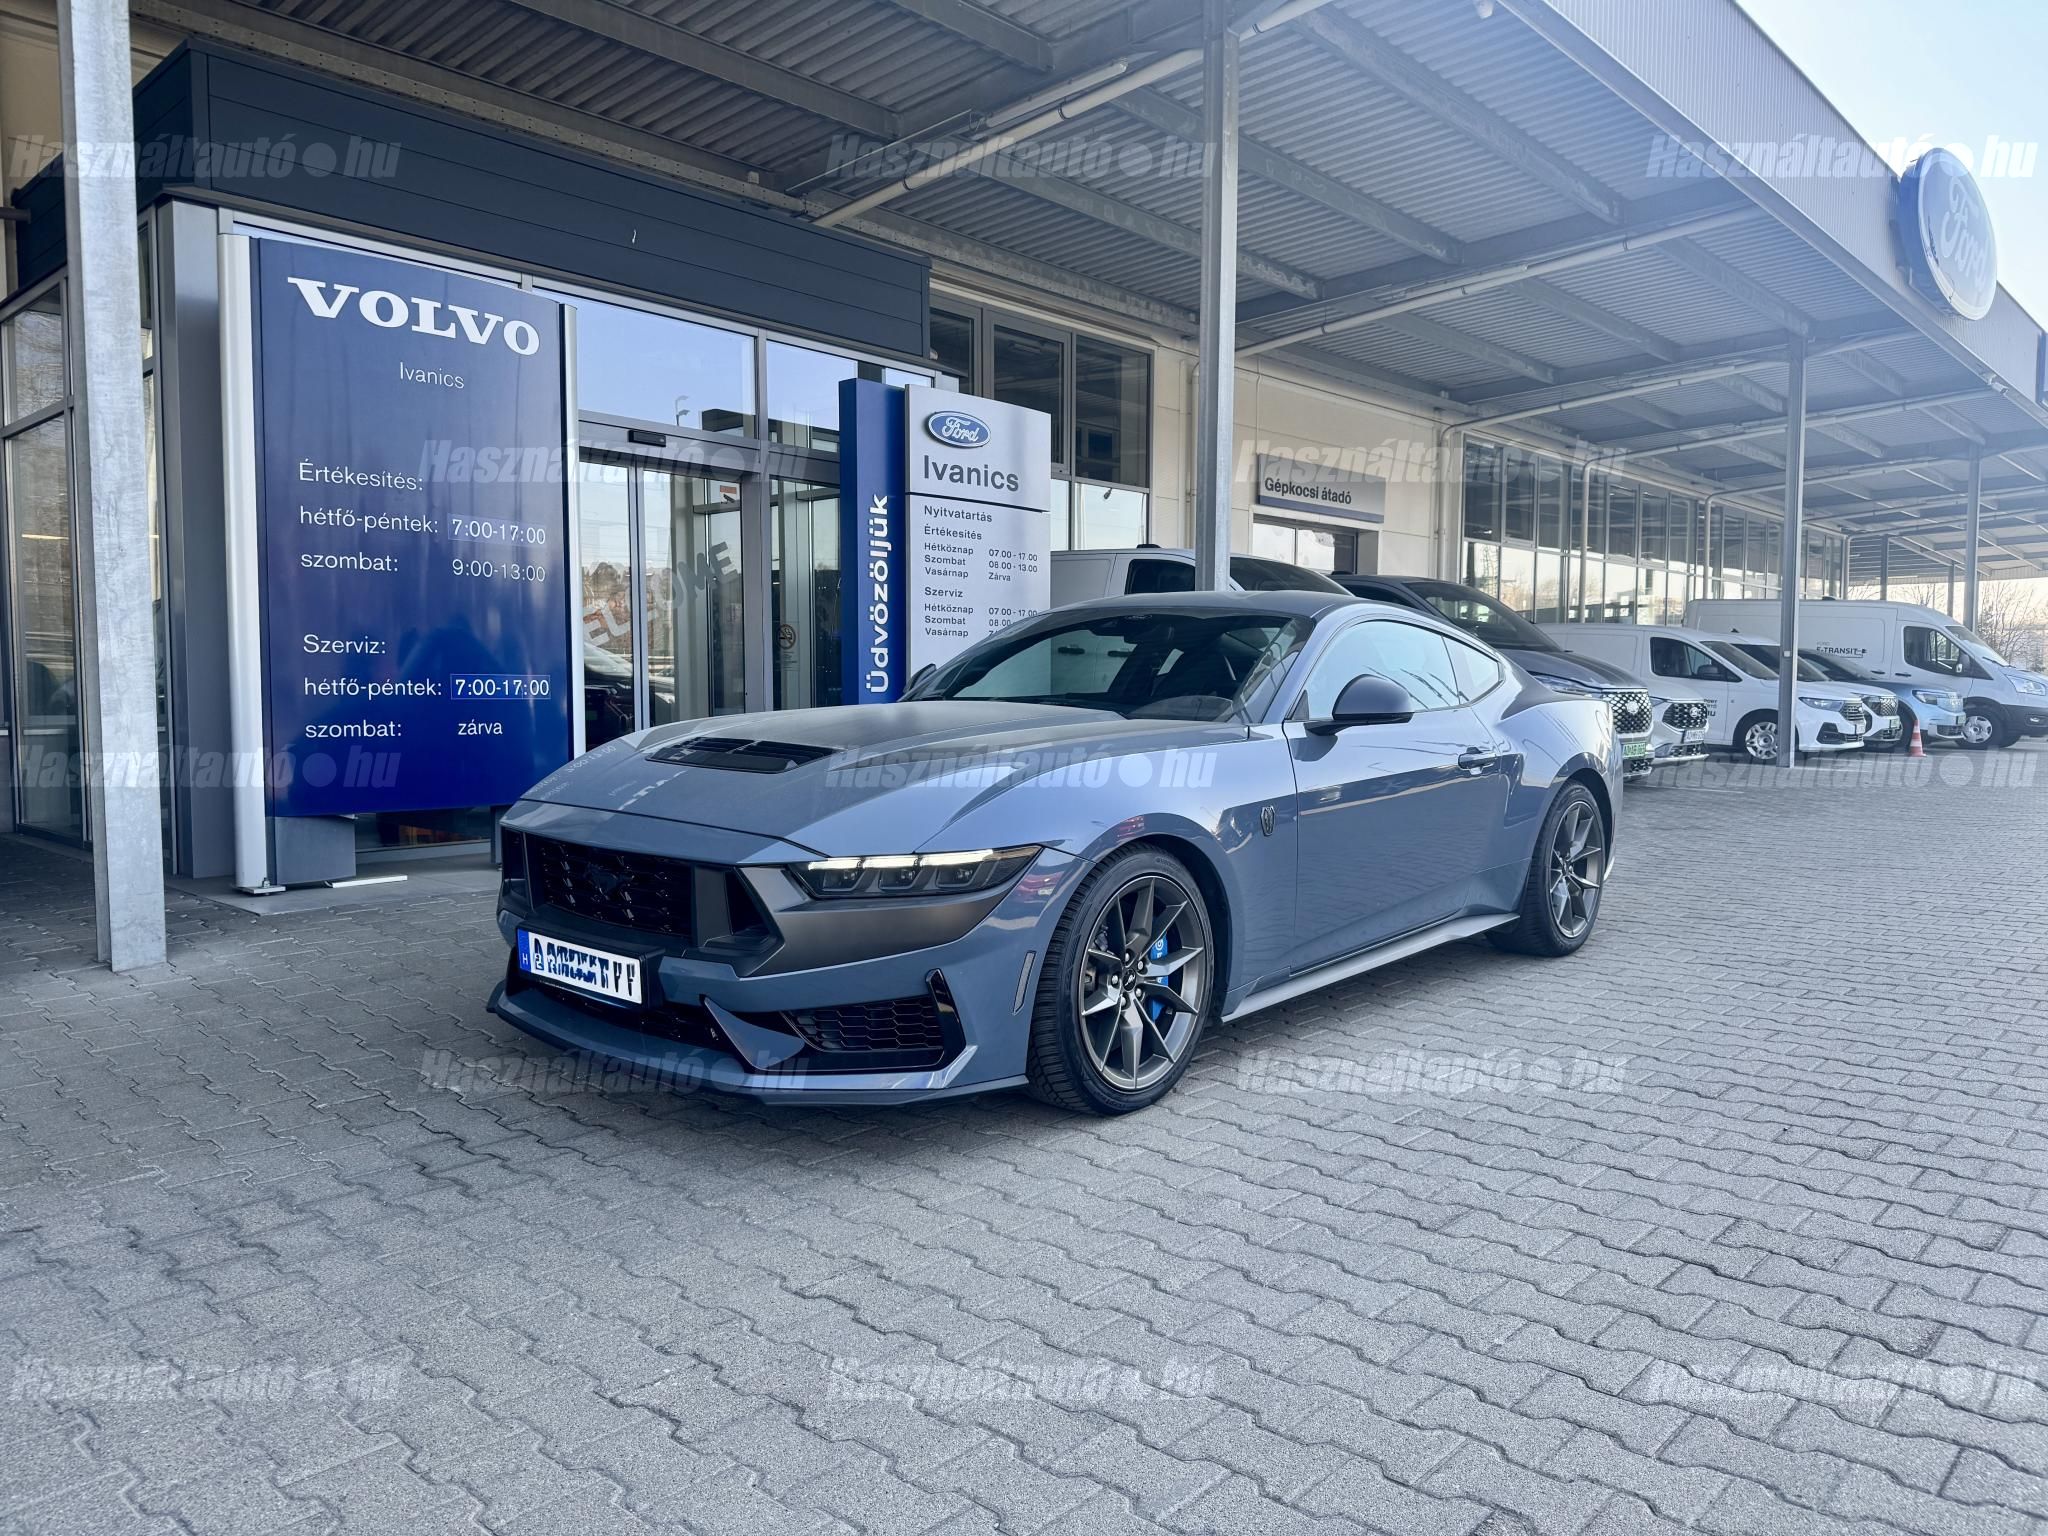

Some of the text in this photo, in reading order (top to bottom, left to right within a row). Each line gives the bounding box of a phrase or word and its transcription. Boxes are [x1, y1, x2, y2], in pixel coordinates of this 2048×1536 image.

[1940, 177, 1988, 290] Ford
[287, 276, 540, 356] VOLVO
[399, 361, 465, 389] Ivanics
[941, 416, 980, 442] Ford
[299, 458, 424, 491] Értékesítés:
[923, 454, 1019, 492] Ivanics
[1264, 477, 1352, 505] Gépkocsi átadó
[924, 505, 993, 522] Nyitvatartás
[300, 506, 546, 545] hétfő-péntek: 7:00-17:00
[924, 543, 974, 555] Hétköznap
[988, 549, 1012, 559] 07.00
[1018, 552, 1038, 561] 17.00
[301, 551, 546, 582] szombat: 9:00-13:00
[924, 554, 966, 566] Szombat
[988, 560, 1012, 570] 08.00
[1018, 563, 1038, 573] 13.00
[925, 566, 1011, 581] Vasárnap Zárva
[866, 494, 892, 693] Üdvözöljük
[924, 586, 964, 598] Szerviz
[924, 603, 974, 614] Hétköznap
[988, 607, 1012, 616] 07.00
[924, 615, 966, 625] Szombat
[925, 627, 969, 637] Vasárnap
[303, 633, 386, 654] Szerviz:
[304, 677, 549, 701] hétfő-péntek: 7:00-17:00
[305, 718, 503, 738] szombat: zárva
[522, 953, 529, 965] H
